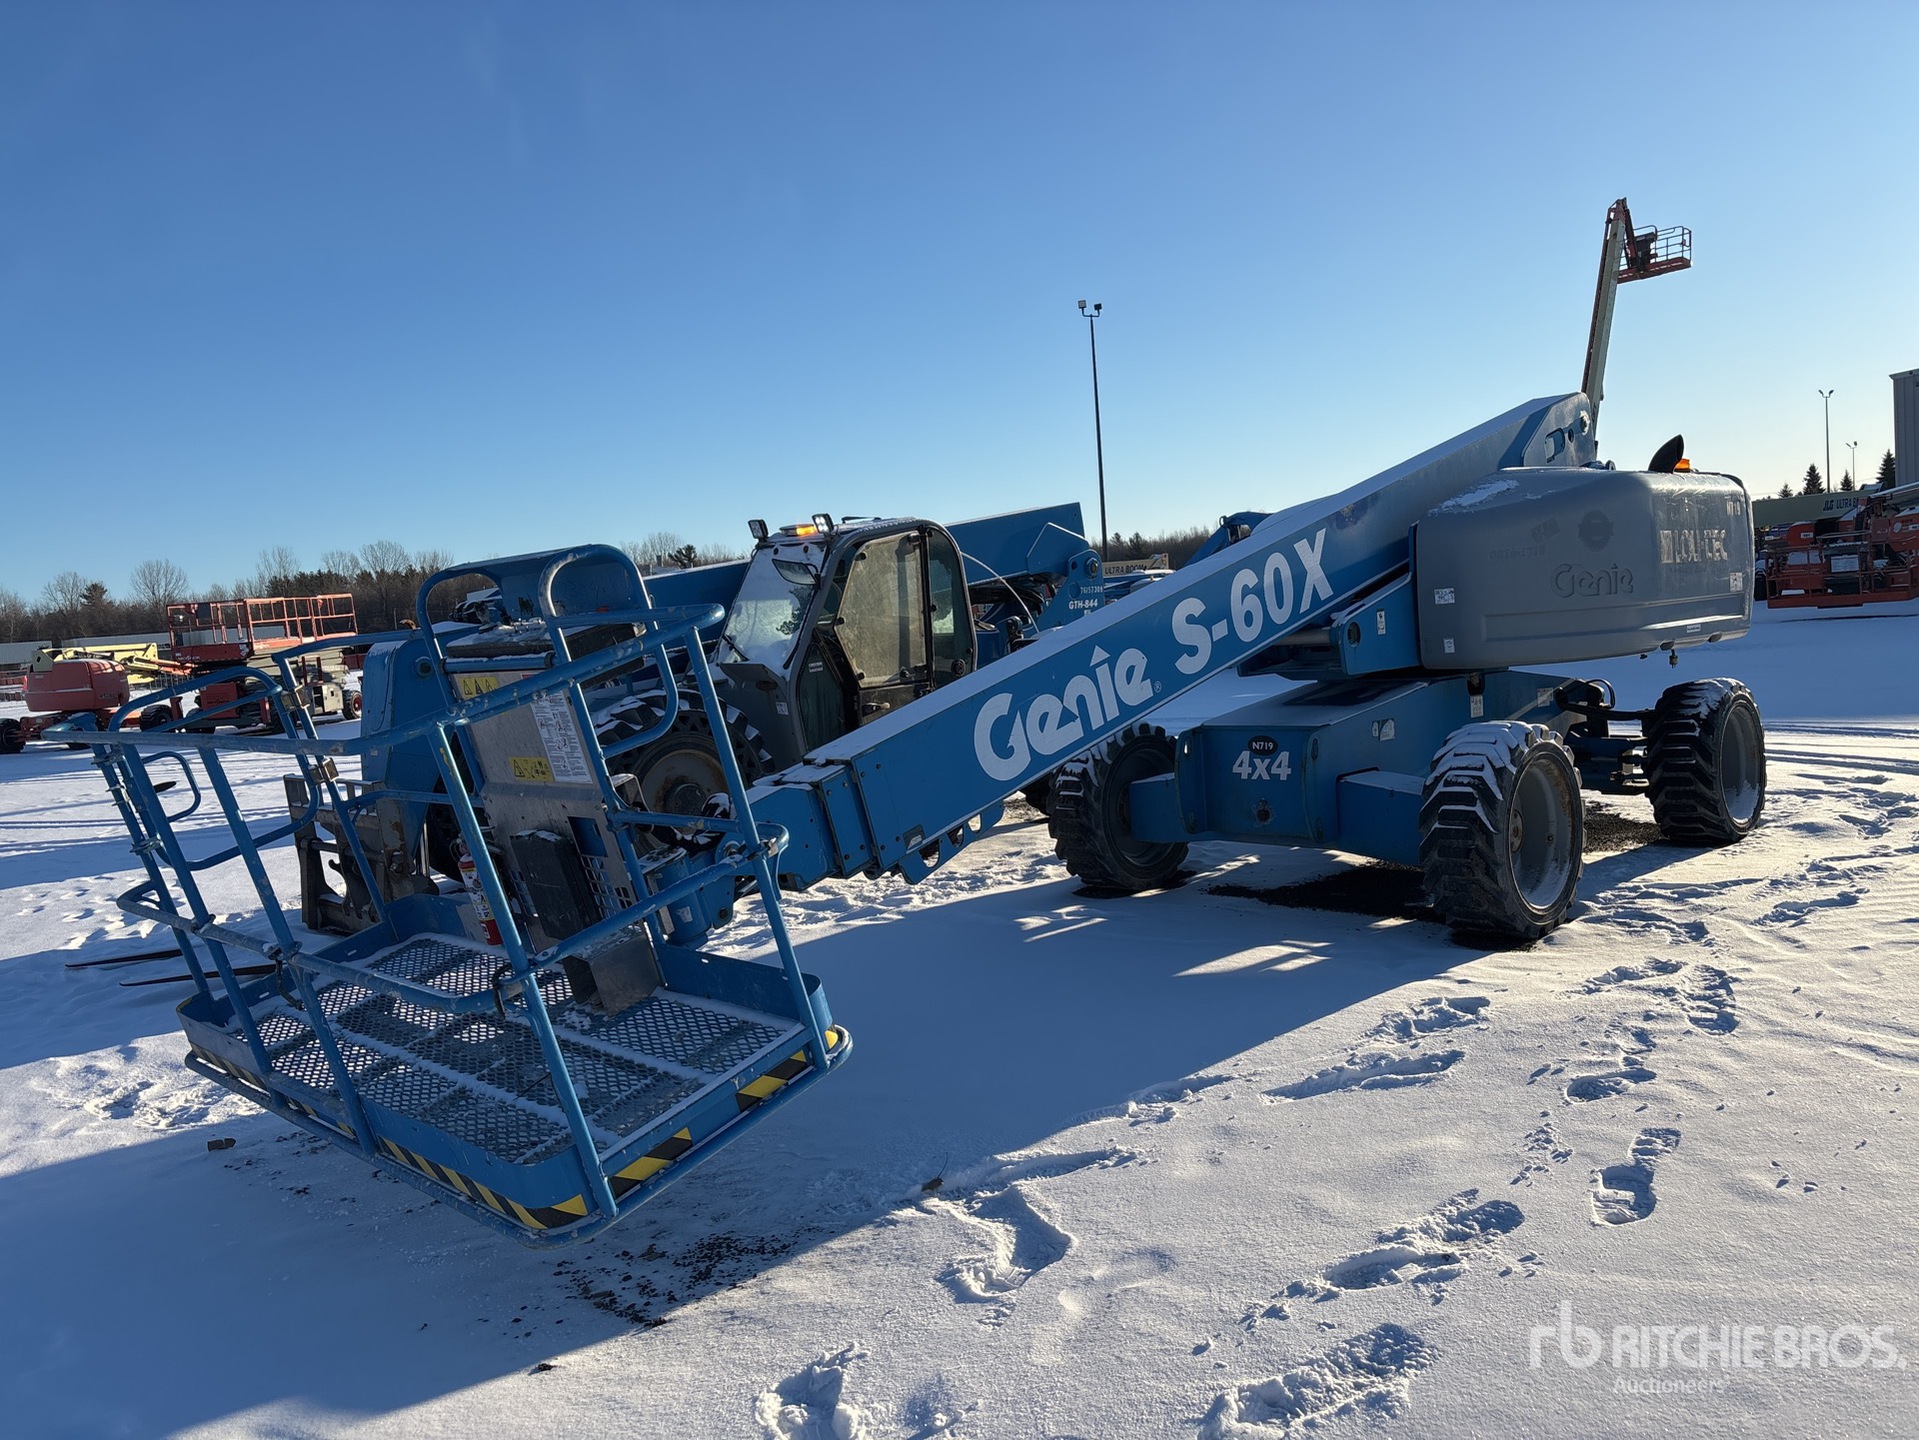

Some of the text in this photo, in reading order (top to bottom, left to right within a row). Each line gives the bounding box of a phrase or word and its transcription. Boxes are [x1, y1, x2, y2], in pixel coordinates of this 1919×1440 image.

[1104, 565, 1124, 575] ULTRA
[1554, 563, 1634, 598] Genie
[1068, 599, 1098, 610] GTH-844
[1172, 528, 1334, 674] S-60X
[974, 645, 1154, 781] Genie
[1252, 741, 1274, 750] N719
[1232, 750, 1291, 780] 4x4
